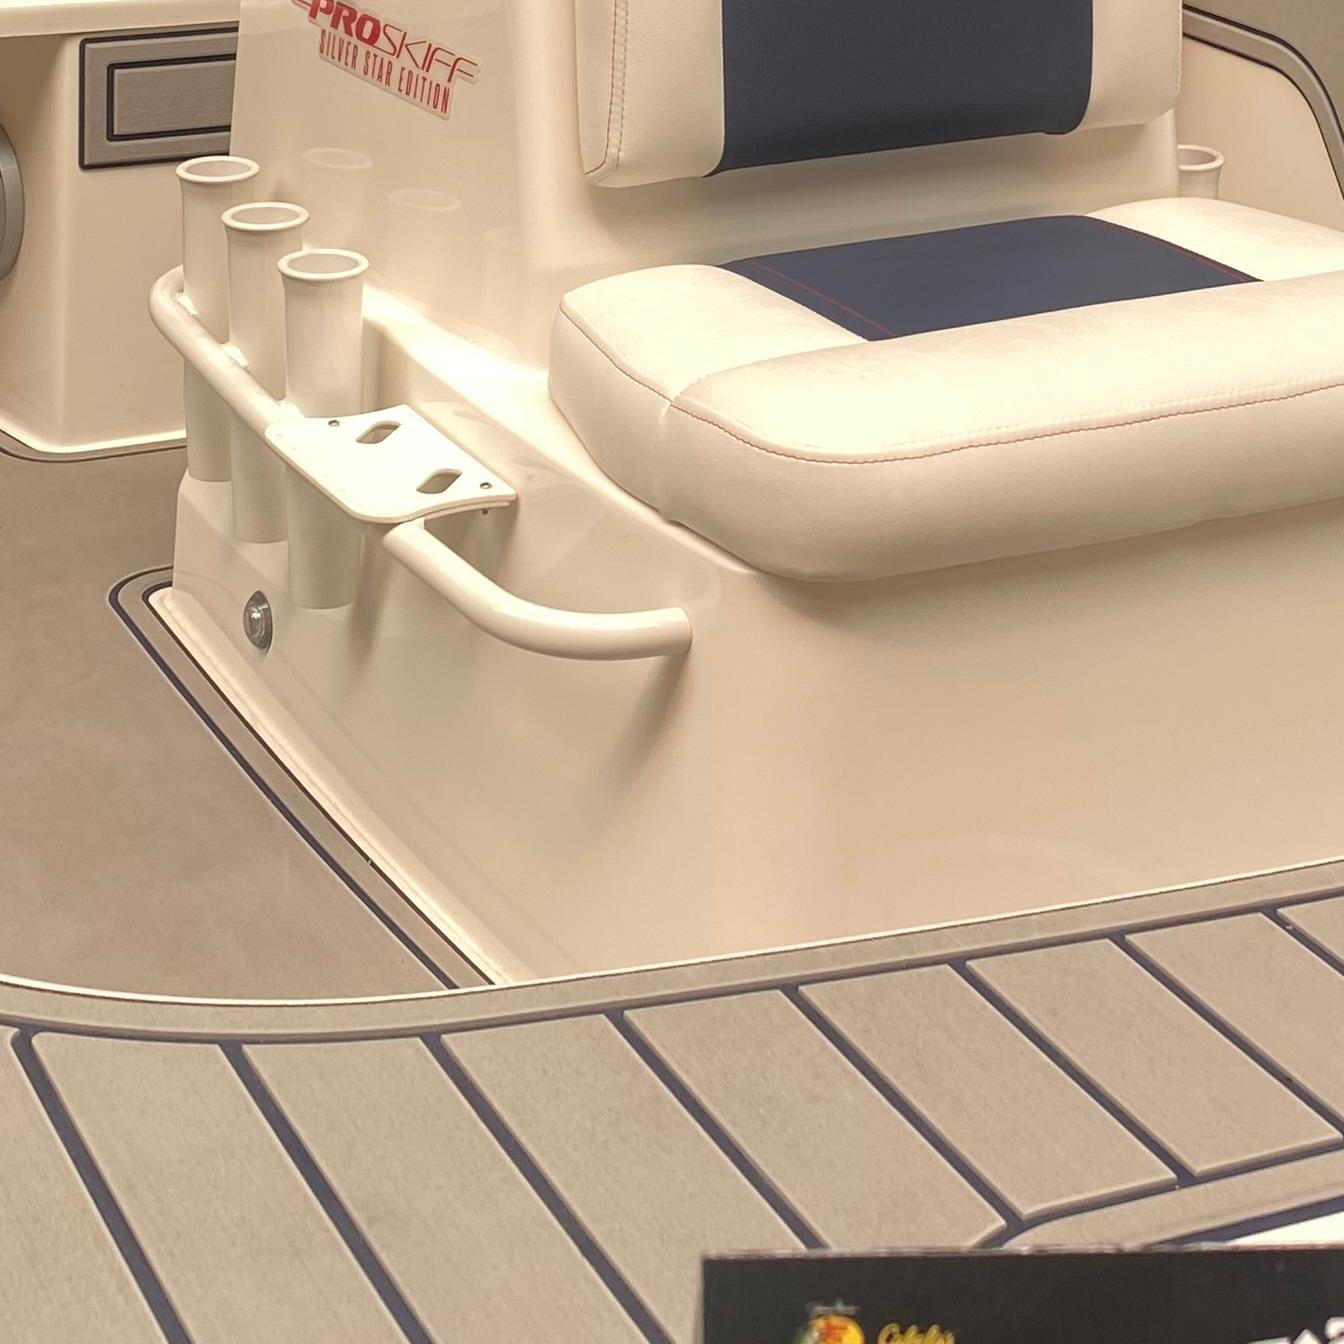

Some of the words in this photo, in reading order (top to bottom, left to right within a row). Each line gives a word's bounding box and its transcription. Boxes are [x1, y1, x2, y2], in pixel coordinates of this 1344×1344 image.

[319, 29, 357, 71] SILVER
[363, 50, 392, 88] STAR
[397, 67, 451, 114] EDITION
